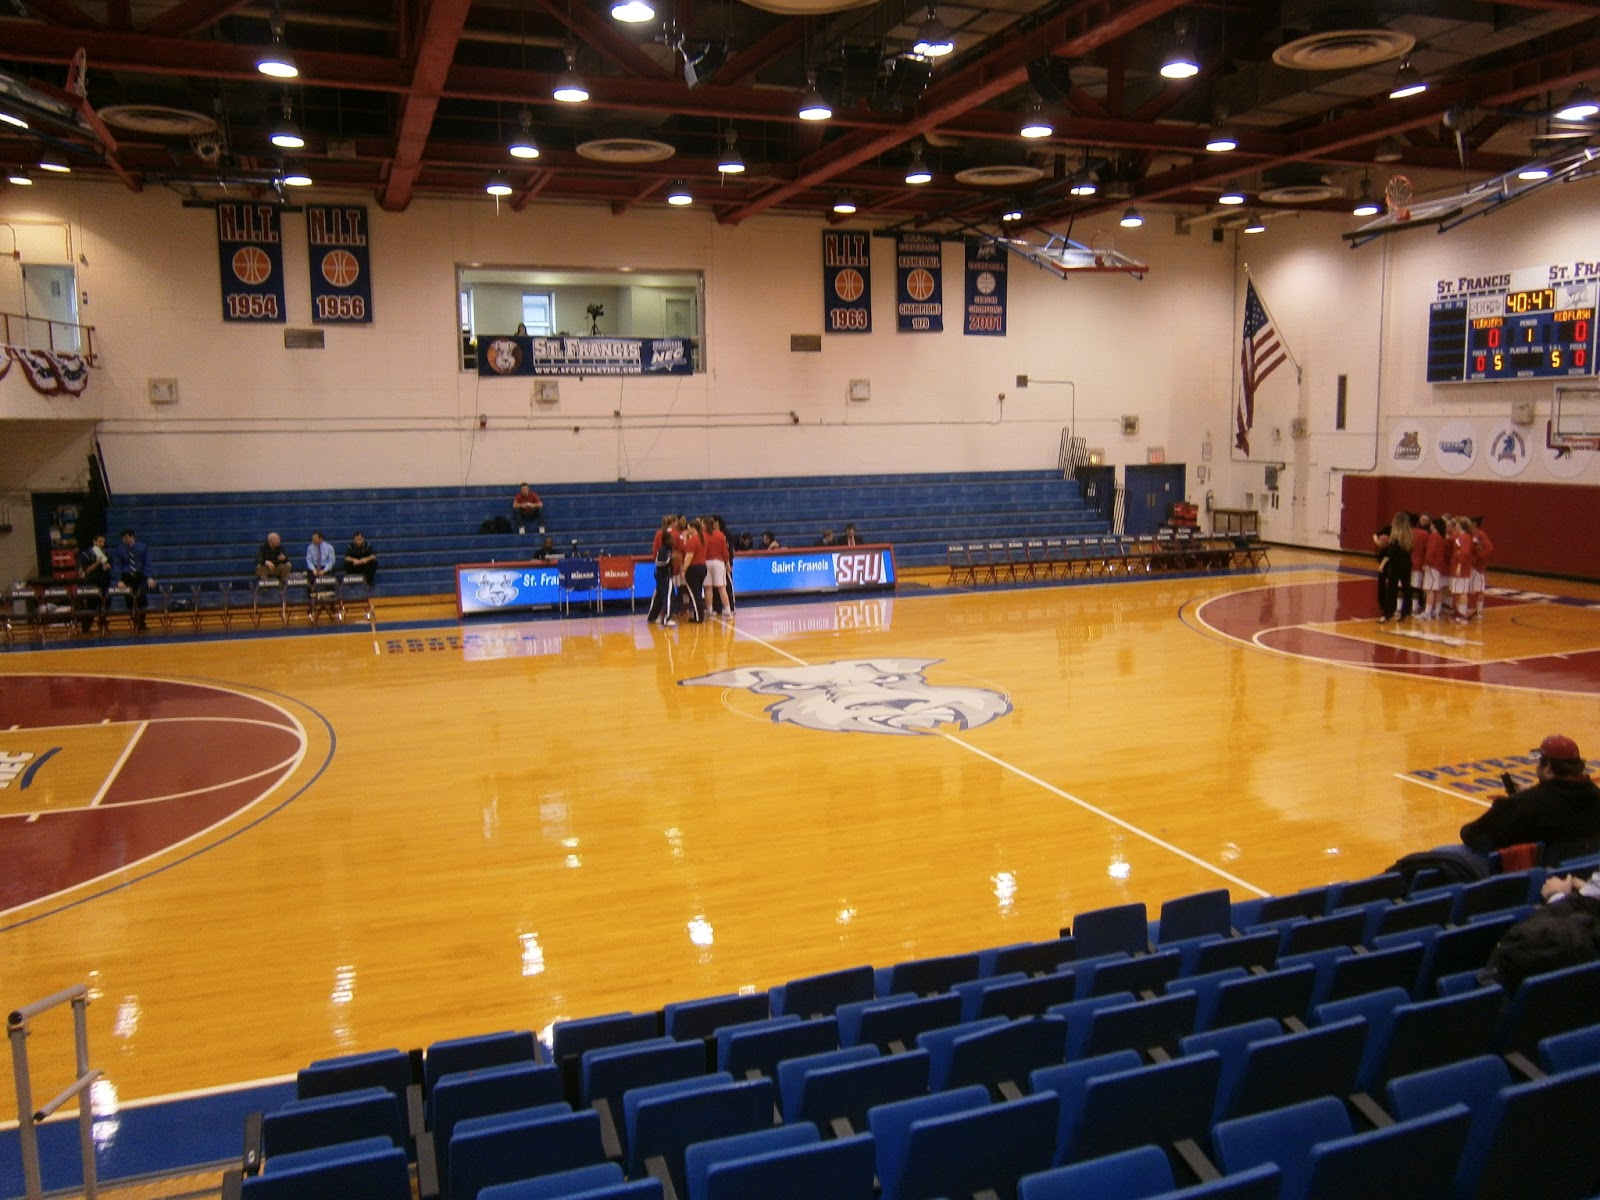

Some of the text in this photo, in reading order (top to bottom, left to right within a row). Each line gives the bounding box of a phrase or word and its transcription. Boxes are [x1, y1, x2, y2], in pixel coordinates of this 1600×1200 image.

[1549, 265, 1570, 280] ST.
[1437, 274, 1511, 293] ST. FRANCIS
[228, 293, 278, 318] 1954
[316, 295, 365, 320] 1956
[1507, 289, 1554, 313] 40:47
[831, 308, 868, 330] 1963
[968, 315, 1003, 331] 2001
[1488, 328, 1500, 348] 0
[1527, 328, 1533, 343] 1
[1575, 320, 1588, 342] 0
[532, 338, 563, 359] ST.
[564, 338, 642, 359] FRANCIS
[1574, 349, 1586, 367] 0
[1476, 355, 1486, 372] 0
[771, 559, 829, 574] Saint Francis
[838, 553, 880, 584] SFU
[523, 573, 537, 587] St.
